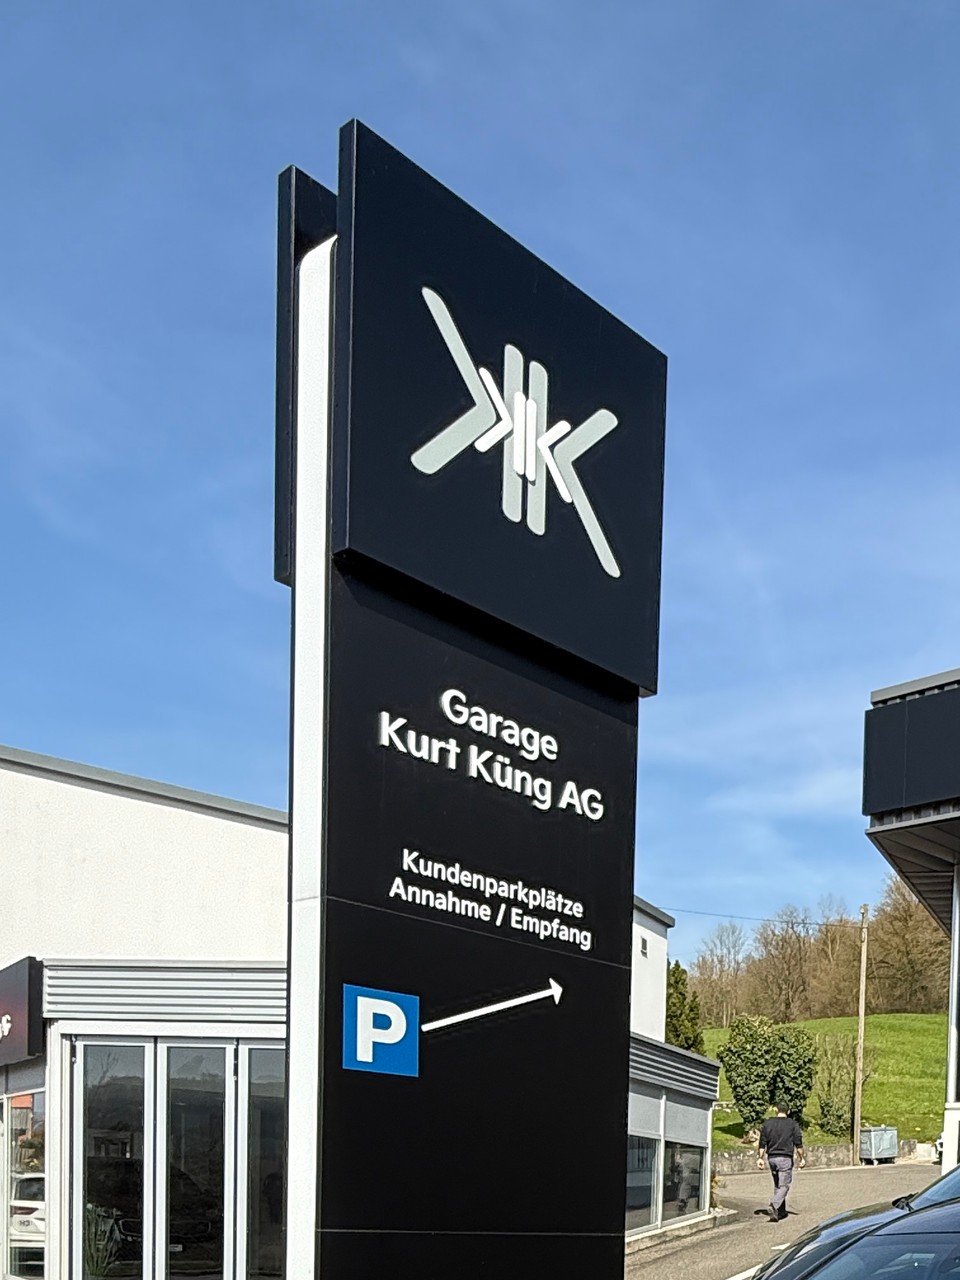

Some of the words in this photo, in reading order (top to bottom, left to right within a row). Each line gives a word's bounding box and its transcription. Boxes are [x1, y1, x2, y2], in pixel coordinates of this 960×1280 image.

[441, 688, 559, 761] Garage
[380, 711, 461, 770] Kurt
[469, 745, 552, 811] Küng
[557, 780, 604, 821] AG
[388, 876, 492, 922] Annahme
[510, 907, 592, 951] Empfang
[402, 848, 583, 918] Kundenparkplätze
[356, 996, 407, 1063] P
